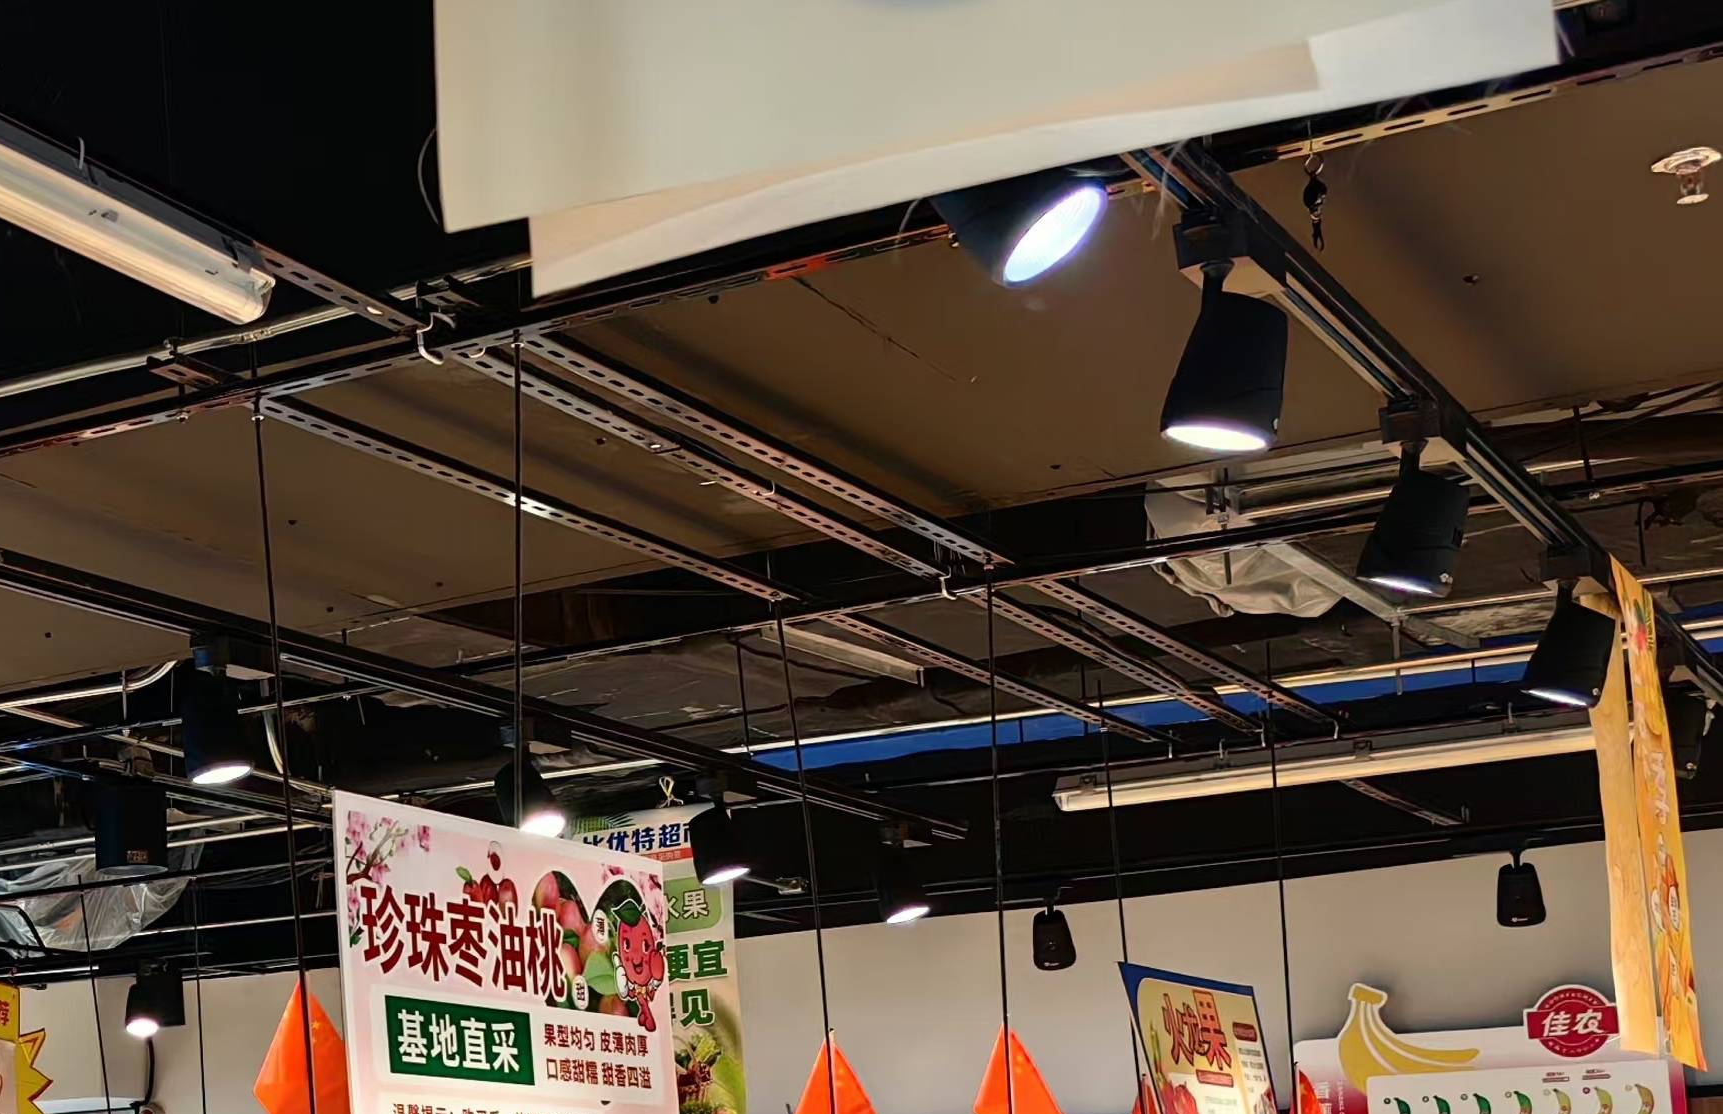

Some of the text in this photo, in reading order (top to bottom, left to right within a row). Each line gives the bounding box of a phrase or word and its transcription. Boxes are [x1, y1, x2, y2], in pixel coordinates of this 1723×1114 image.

[360, 884, 567, 1001] 珍珠枣油桃
[396, 1008, 521, 1074] 基地直采
[544, 1023, 648, 1057] 果型均匀 皮薄肉厚
[1541, 1009, 1605, 1038] 佳农
